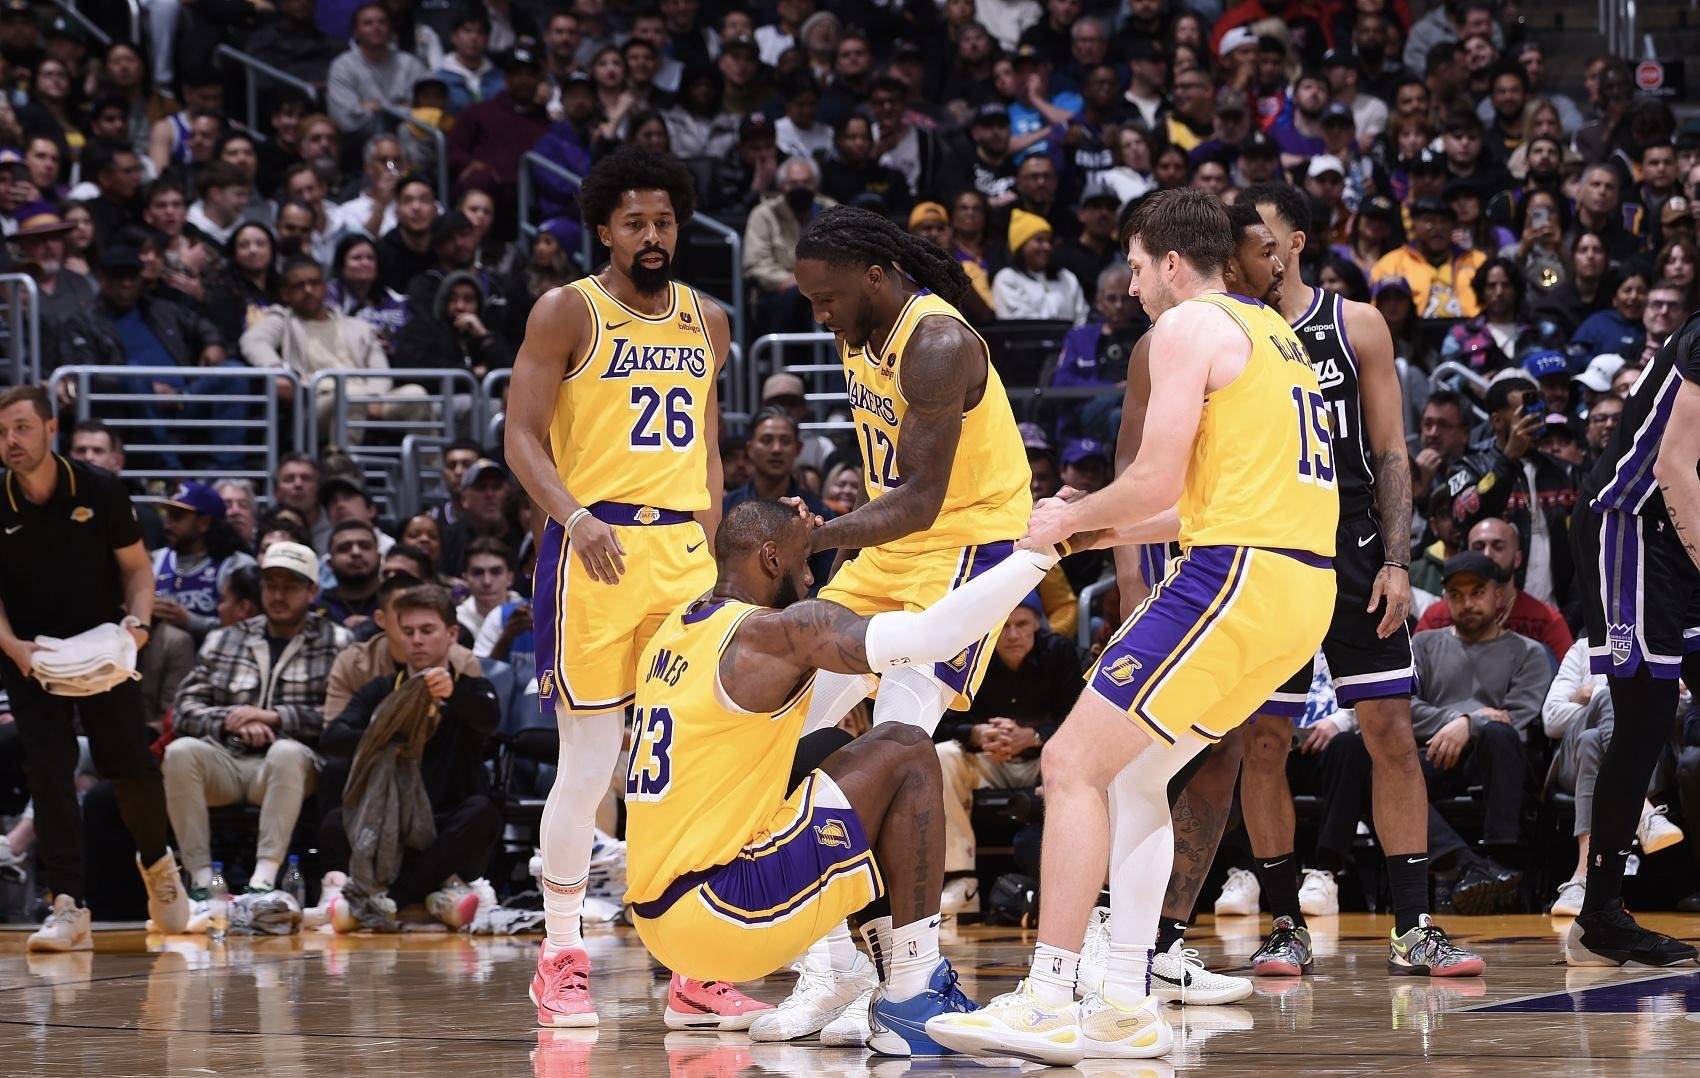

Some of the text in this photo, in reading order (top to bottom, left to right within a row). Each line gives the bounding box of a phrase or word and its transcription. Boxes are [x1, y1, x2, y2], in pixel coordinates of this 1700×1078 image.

[600, 338, 707, 379] LAKERS
[1303, 322, 1335, 334] dialpad
[630, 386, 695, 448] 26
[1291, 385, 1335, 486] 15
[862, 422, 907, 489] 12
[645, 648, 689, 687] JMES
[626, 706, 674, 797] 23
